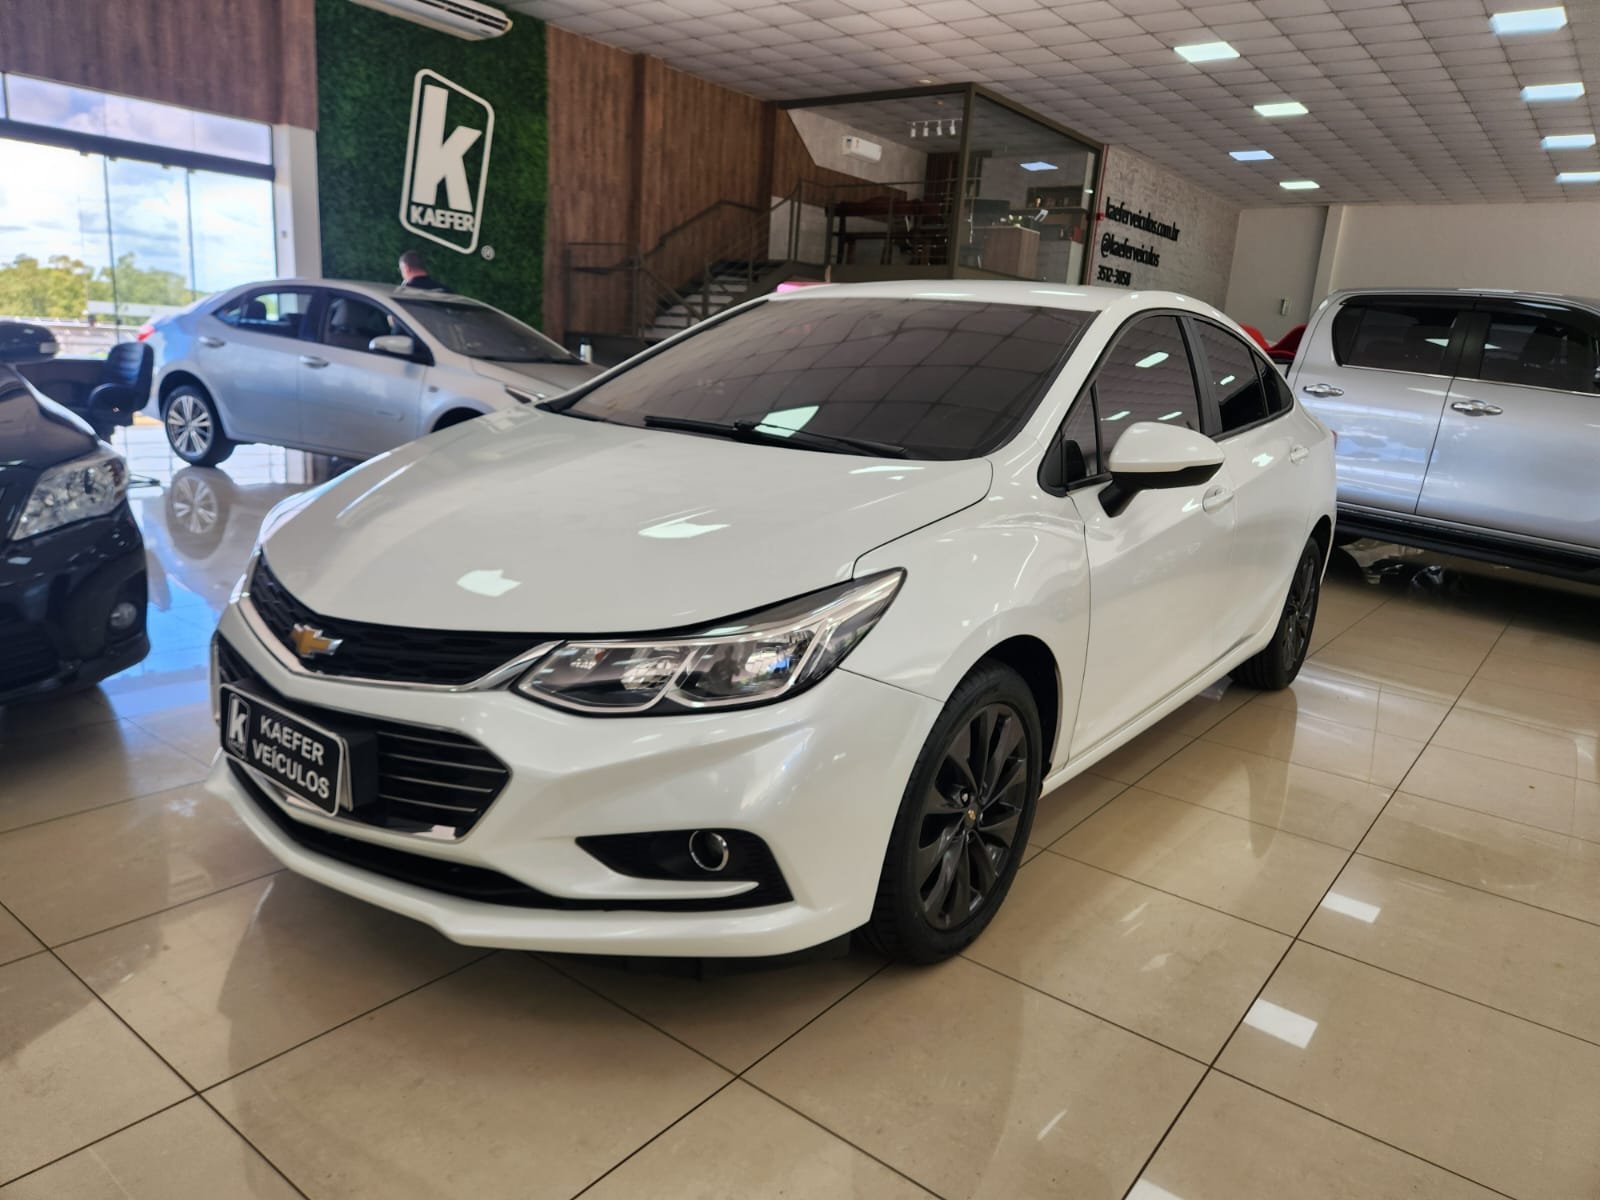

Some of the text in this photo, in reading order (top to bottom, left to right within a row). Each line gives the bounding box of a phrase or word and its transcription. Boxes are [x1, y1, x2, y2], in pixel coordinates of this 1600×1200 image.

[410, 204, 475, 233] KAEFER
[260, 715, 324, 766] KAEFER
[252, 738, 330, 799] VEÍCULOS
